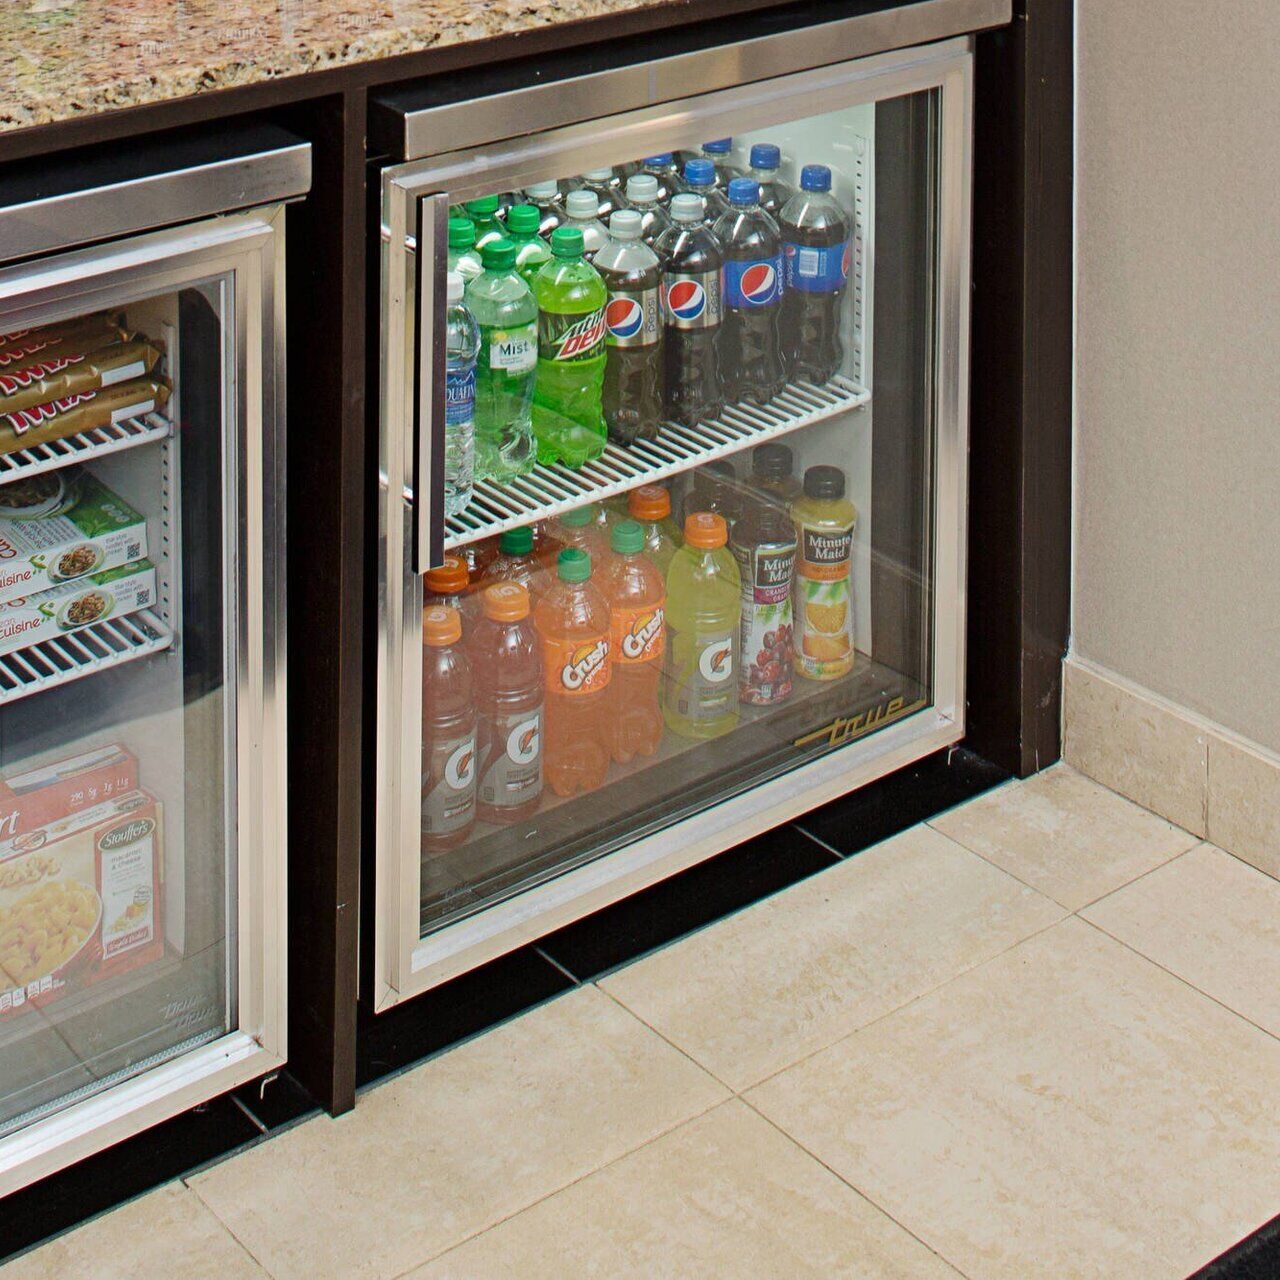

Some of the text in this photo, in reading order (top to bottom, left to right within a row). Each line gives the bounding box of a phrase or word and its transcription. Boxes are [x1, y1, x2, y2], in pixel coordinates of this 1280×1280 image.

[499, 341, 529, 356] Mist
[809, 534, 851, 548] Minute
[815, 547, 845, 560] Maid
[764, 556, 795, 571] Minu
[622, 608, 665, 659] Crush
[561, 640, 609, 691] Crush
[104, 820, 149, 847] Stouffer's
